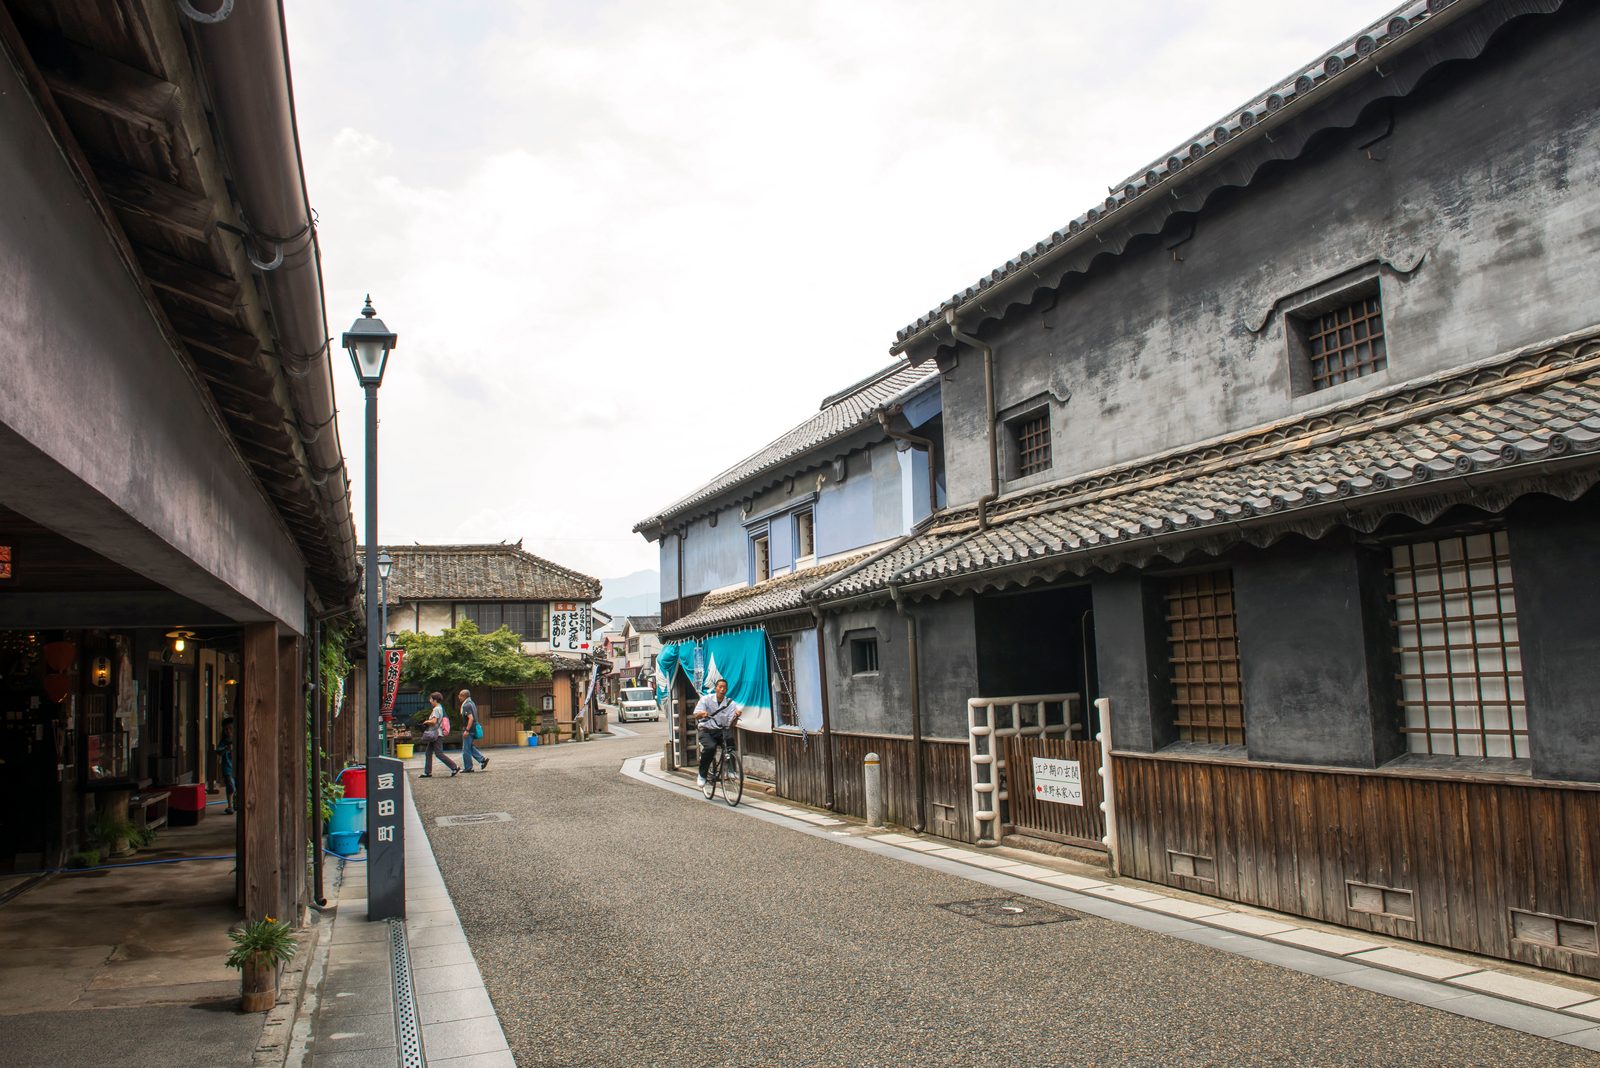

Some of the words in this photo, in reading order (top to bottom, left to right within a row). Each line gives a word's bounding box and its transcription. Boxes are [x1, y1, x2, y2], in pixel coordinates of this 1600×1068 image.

[552, 614, 561, 648] 釜めし
[1035, 761, 1079, 780] 江戸期の玄関
[1042, 784, 1081, 799] 草野本家入口
[377, 772, 396, 843] 豆田町
